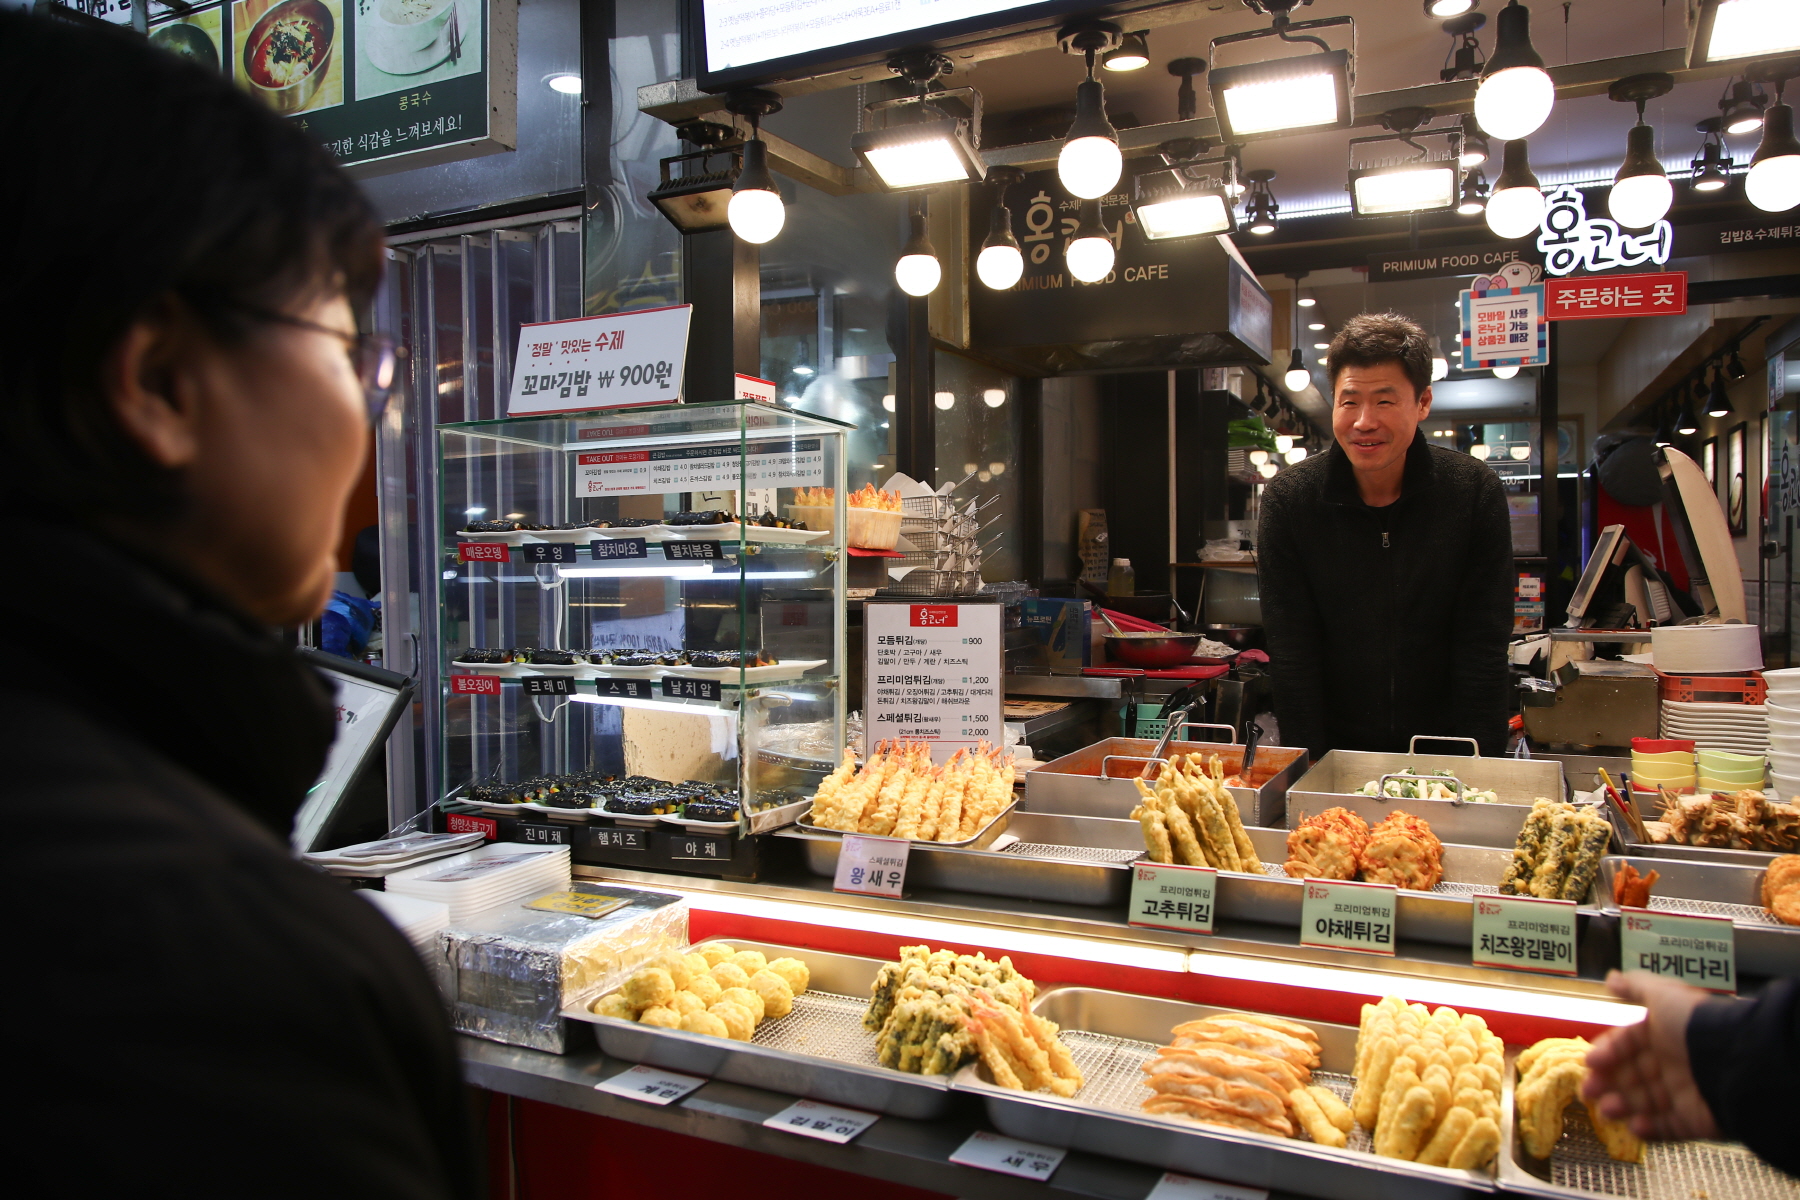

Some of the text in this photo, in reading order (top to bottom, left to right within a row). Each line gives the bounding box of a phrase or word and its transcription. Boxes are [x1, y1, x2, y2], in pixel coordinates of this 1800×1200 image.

[398, 91, 431, 111] 콩국수
[357, 128, 393, 151] 식감을
[395, 114, 462, 143] 느껴보세요!
[1383, 250, 1520, 273] PRIMIUM FOOD CAFE
[1124, 263, 1169, 283] CAFE
[1555, 284, 1675, 310] 주문하는 곳
[1477, 308, 1528, 323] 모바일 사용
[1477, 321, 1528, 335] 온누리 가능
[561, 338, 592, 355] 맛있는
[594, 330, 625, 351] 수제
[1477, 332, 1529, 347] 상품권 매장
[521, 370, 592, 399] 꼬마김밥
[619, 360, 673, 389] 900원
[586, 455, 601, 463] TAKE
[602, 454, 614, 462] OUT
[465, 543, 503, 559] 매운오뎅
[598, 542, 639, 557] 참치마요
[670, 544, 714, 558] 멸치볶음
[968, 637, 983, 645] 900
[877, 658, 896, 666] 김말이
[923, 658, 936, 666] 계란
[457, 678, 494, 693] 불오징어
[530, 680, 568, 693] 크래미
[968, 676, 989, 684] 1,200
[670, 680, 711, 697] 날치알
[906, 688, 936, 696] 오징어튀김
[970, 688, 993, 696] 대게다리
[968, 715, 989, 723] 1,500
[968, 728, 989, 736] 2,000
[450, 816, 493, 837] 청양소불고기
[525, 828, 562, 844] 진미채
[598, 831, 637, 846] 햄치즈
[685, 842, 716, 857] 야채
[869, 856, 904, 867] 스페셜튀김
[850, 867, 901, 889] 왕새우
[1159, 885, 1211, 899] 프리미엄튀김
[1141, 899, 1210, 923] 고추튀김
[1333, 903, 1391, 918] 프리미엄튀김
[1315, 917, 1391, 944] 야채튀김
[1507, 920, 1571, 936] 프리미엄튀김
[1480, 933, 1572, 963] 치즈왕김말이
[1658, 935, 1729, 953] 프리미엄튀김
[1639, 952, 1731, 982] 대게다리
[789, 1115, 856, 1137] 김말이
